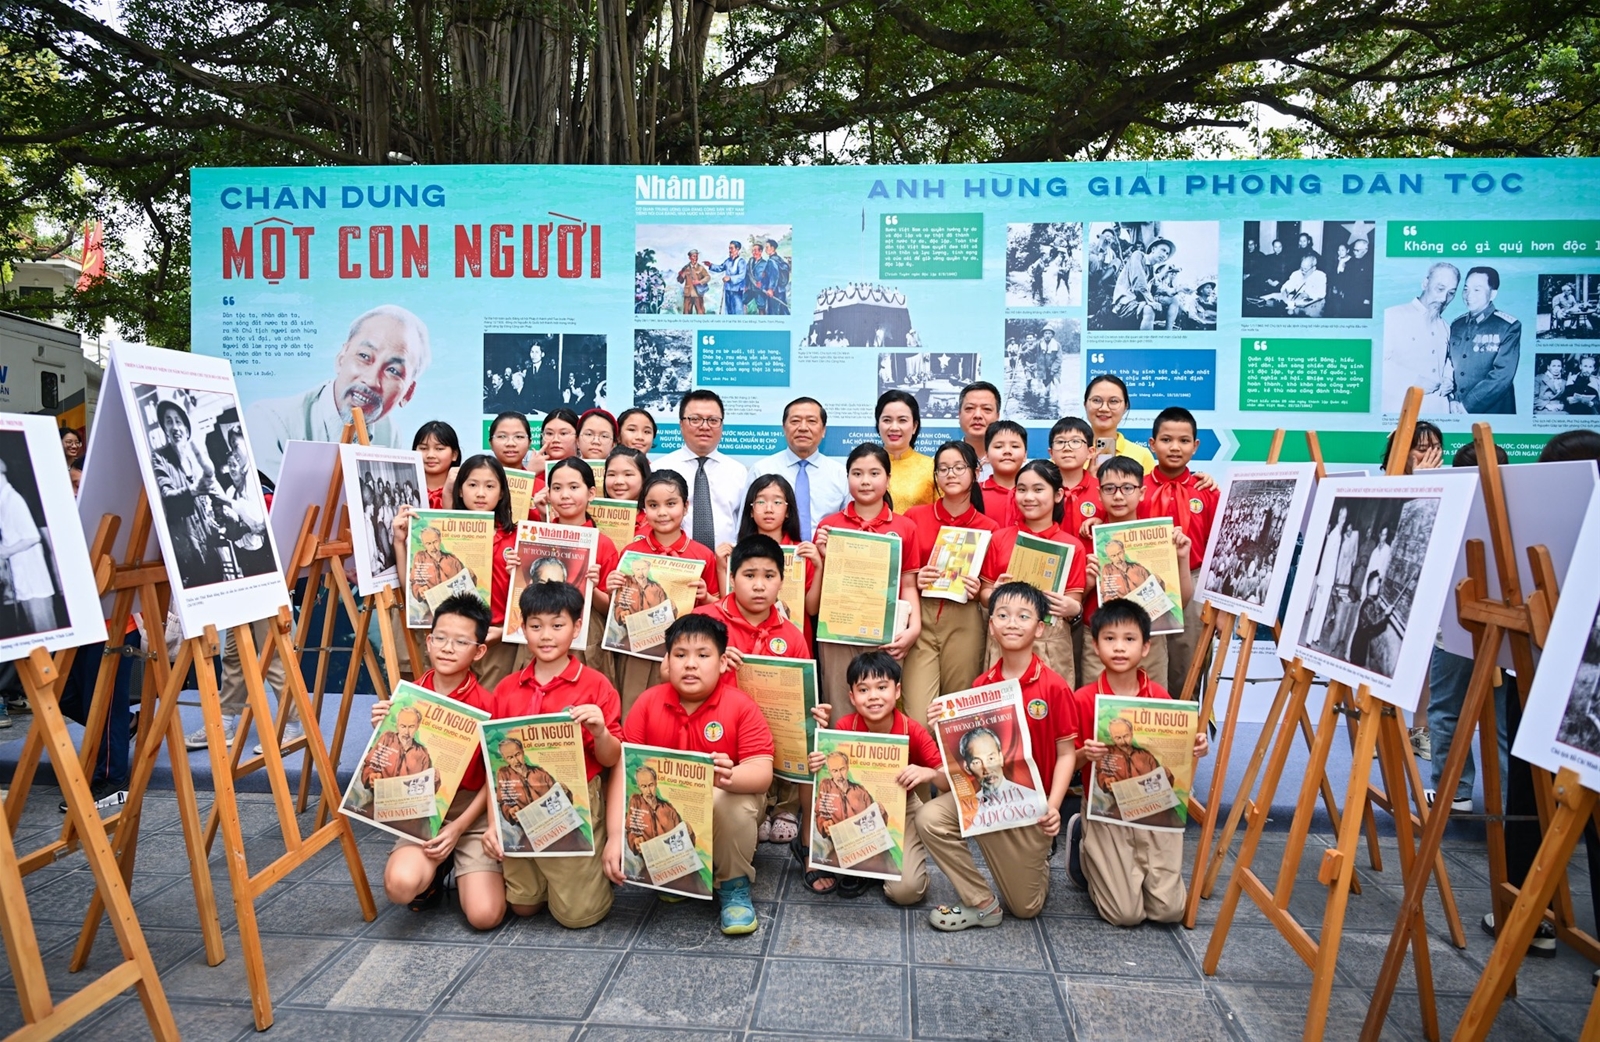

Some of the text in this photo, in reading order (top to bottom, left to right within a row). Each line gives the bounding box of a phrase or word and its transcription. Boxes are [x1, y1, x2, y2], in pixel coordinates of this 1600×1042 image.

[636, 174, 744, 200] Nhân Dân
[867, 178, 944, 198] ANH
[342, 185, 445, 209] DUNG
[222, 211, 601, 285] MỘT CON NGƯỜI
[1404, 240, 1586, 253] Không có gì quý hơn độc
[593, 506, 630, 520] LỜI NGƯỜI
[442, 518, 486, 533] LỜI NGƯỜI
[539, 527, 561, 538] Nhân
[563, 530, 580, 540] Dân
[1124, 526, 1167, 542] LỜI NGƯỜI
[955, 694, 981, 708] Nhân
[981, 690, 1001, 702] Dân
[425, 705, 477, 734] LỜI NGƯỜI
[1134, 708, 1188, 727] LỜI NGƯỜI
[521, 723, 574, 741] LỜI NGƯỜI
[850, 742, 900, 761] LỜI NGƯỜI
[658, 758, 706, 780] LỜI NGƯỜI
